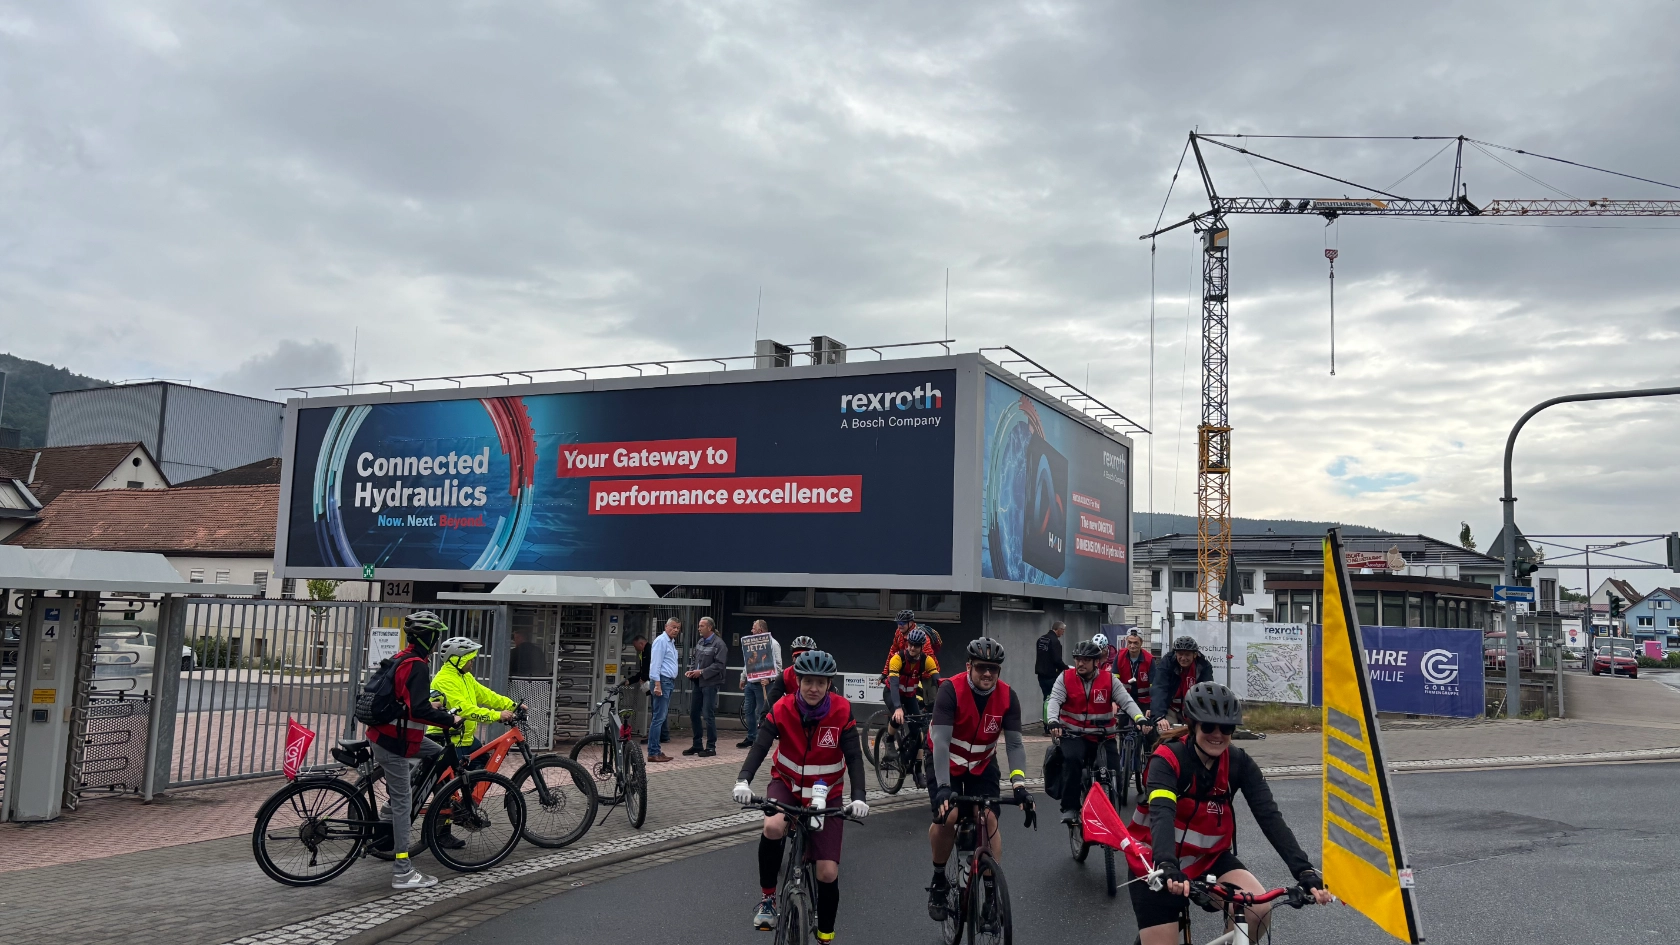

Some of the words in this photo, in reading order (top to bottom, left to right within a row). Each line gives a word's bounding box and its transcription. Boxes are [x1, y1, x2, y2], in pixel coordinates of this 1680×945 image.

[841, 382, 942, 413] rexroth
[840, 419, 848, 429] A
[852, 416, 885, 429] Bosch
[888, 416, 942, 428] Company
[356, 446, 490, 477] Connected
[563, 449, 609, 469] Your
[612, 447, 703, 470] Gateway
[706, 446, 728, 465] to
[1103, 450, 1126, 474] rexroth
[354, 479, 487, 513] Hydraulics
[595, 486, 729, 511] performance
[732, 482, 853, 505] excellence
[377, 514, 405, 527] Now.
[407, 514, 437, 527] Next.
[439, 513, 486, 530] Beyond.
[1081, 515, 1089, 529] The
[1089, 520, 1098, 531] new
[1098, 520, 1114, 536] DIGITAL
[1076, 537, 1101, 554] DIMENSION
[1101, 543, 1106, 555] of
[1106, 544, 1125, 559] Hydraulics
[386, 582, 410, 597] 314
[45, 625, 56, 638] 4
[610, 625, 617, 634] 2
[1264, 625, 1303, 636] rexroth
[746, 642, 768, 653] JETZT
[1363, 649, 1409, 667] AHRE
[1369, 669, 1405, 683] MILIE
[858, 690, 865, 700] 3
[1424, 684, 1460, 692] GÖBEL
